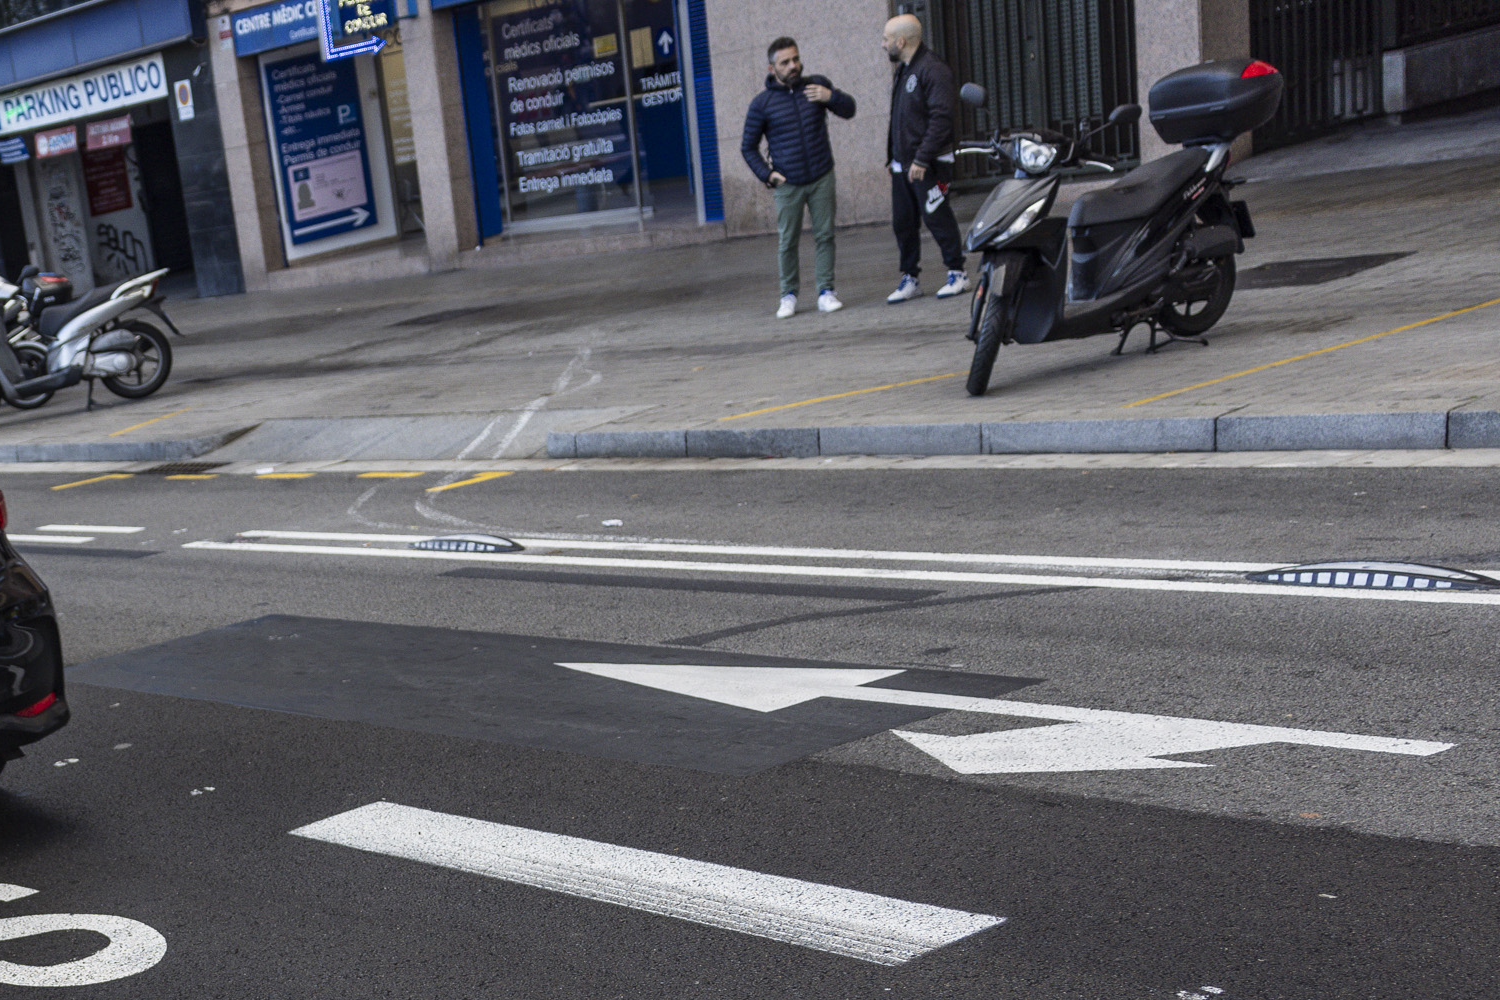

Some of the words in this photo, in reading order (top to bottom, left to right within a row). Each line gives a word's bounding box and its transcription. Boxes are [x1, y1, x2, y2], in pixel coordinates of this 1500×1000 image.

[235, 12, 271, 35] CENTRE
[501, 18, 554, 40] Certificats
[542, 31, 580, 52] oficials
[507, 70, 563, 94] Renovació
[564, 60, 616, 86] permisos
[4, 83, 82, 124] PARKING
[83, 60, 162, 106] PUBLICO
[510, 100, 525, 114] de
[526, 90, 565, 112] conduir
[510, 121, 536, 137] Fotos
[516, 146, 571, 167] Tramitació
[518, 175, 560, 193] Entrega
